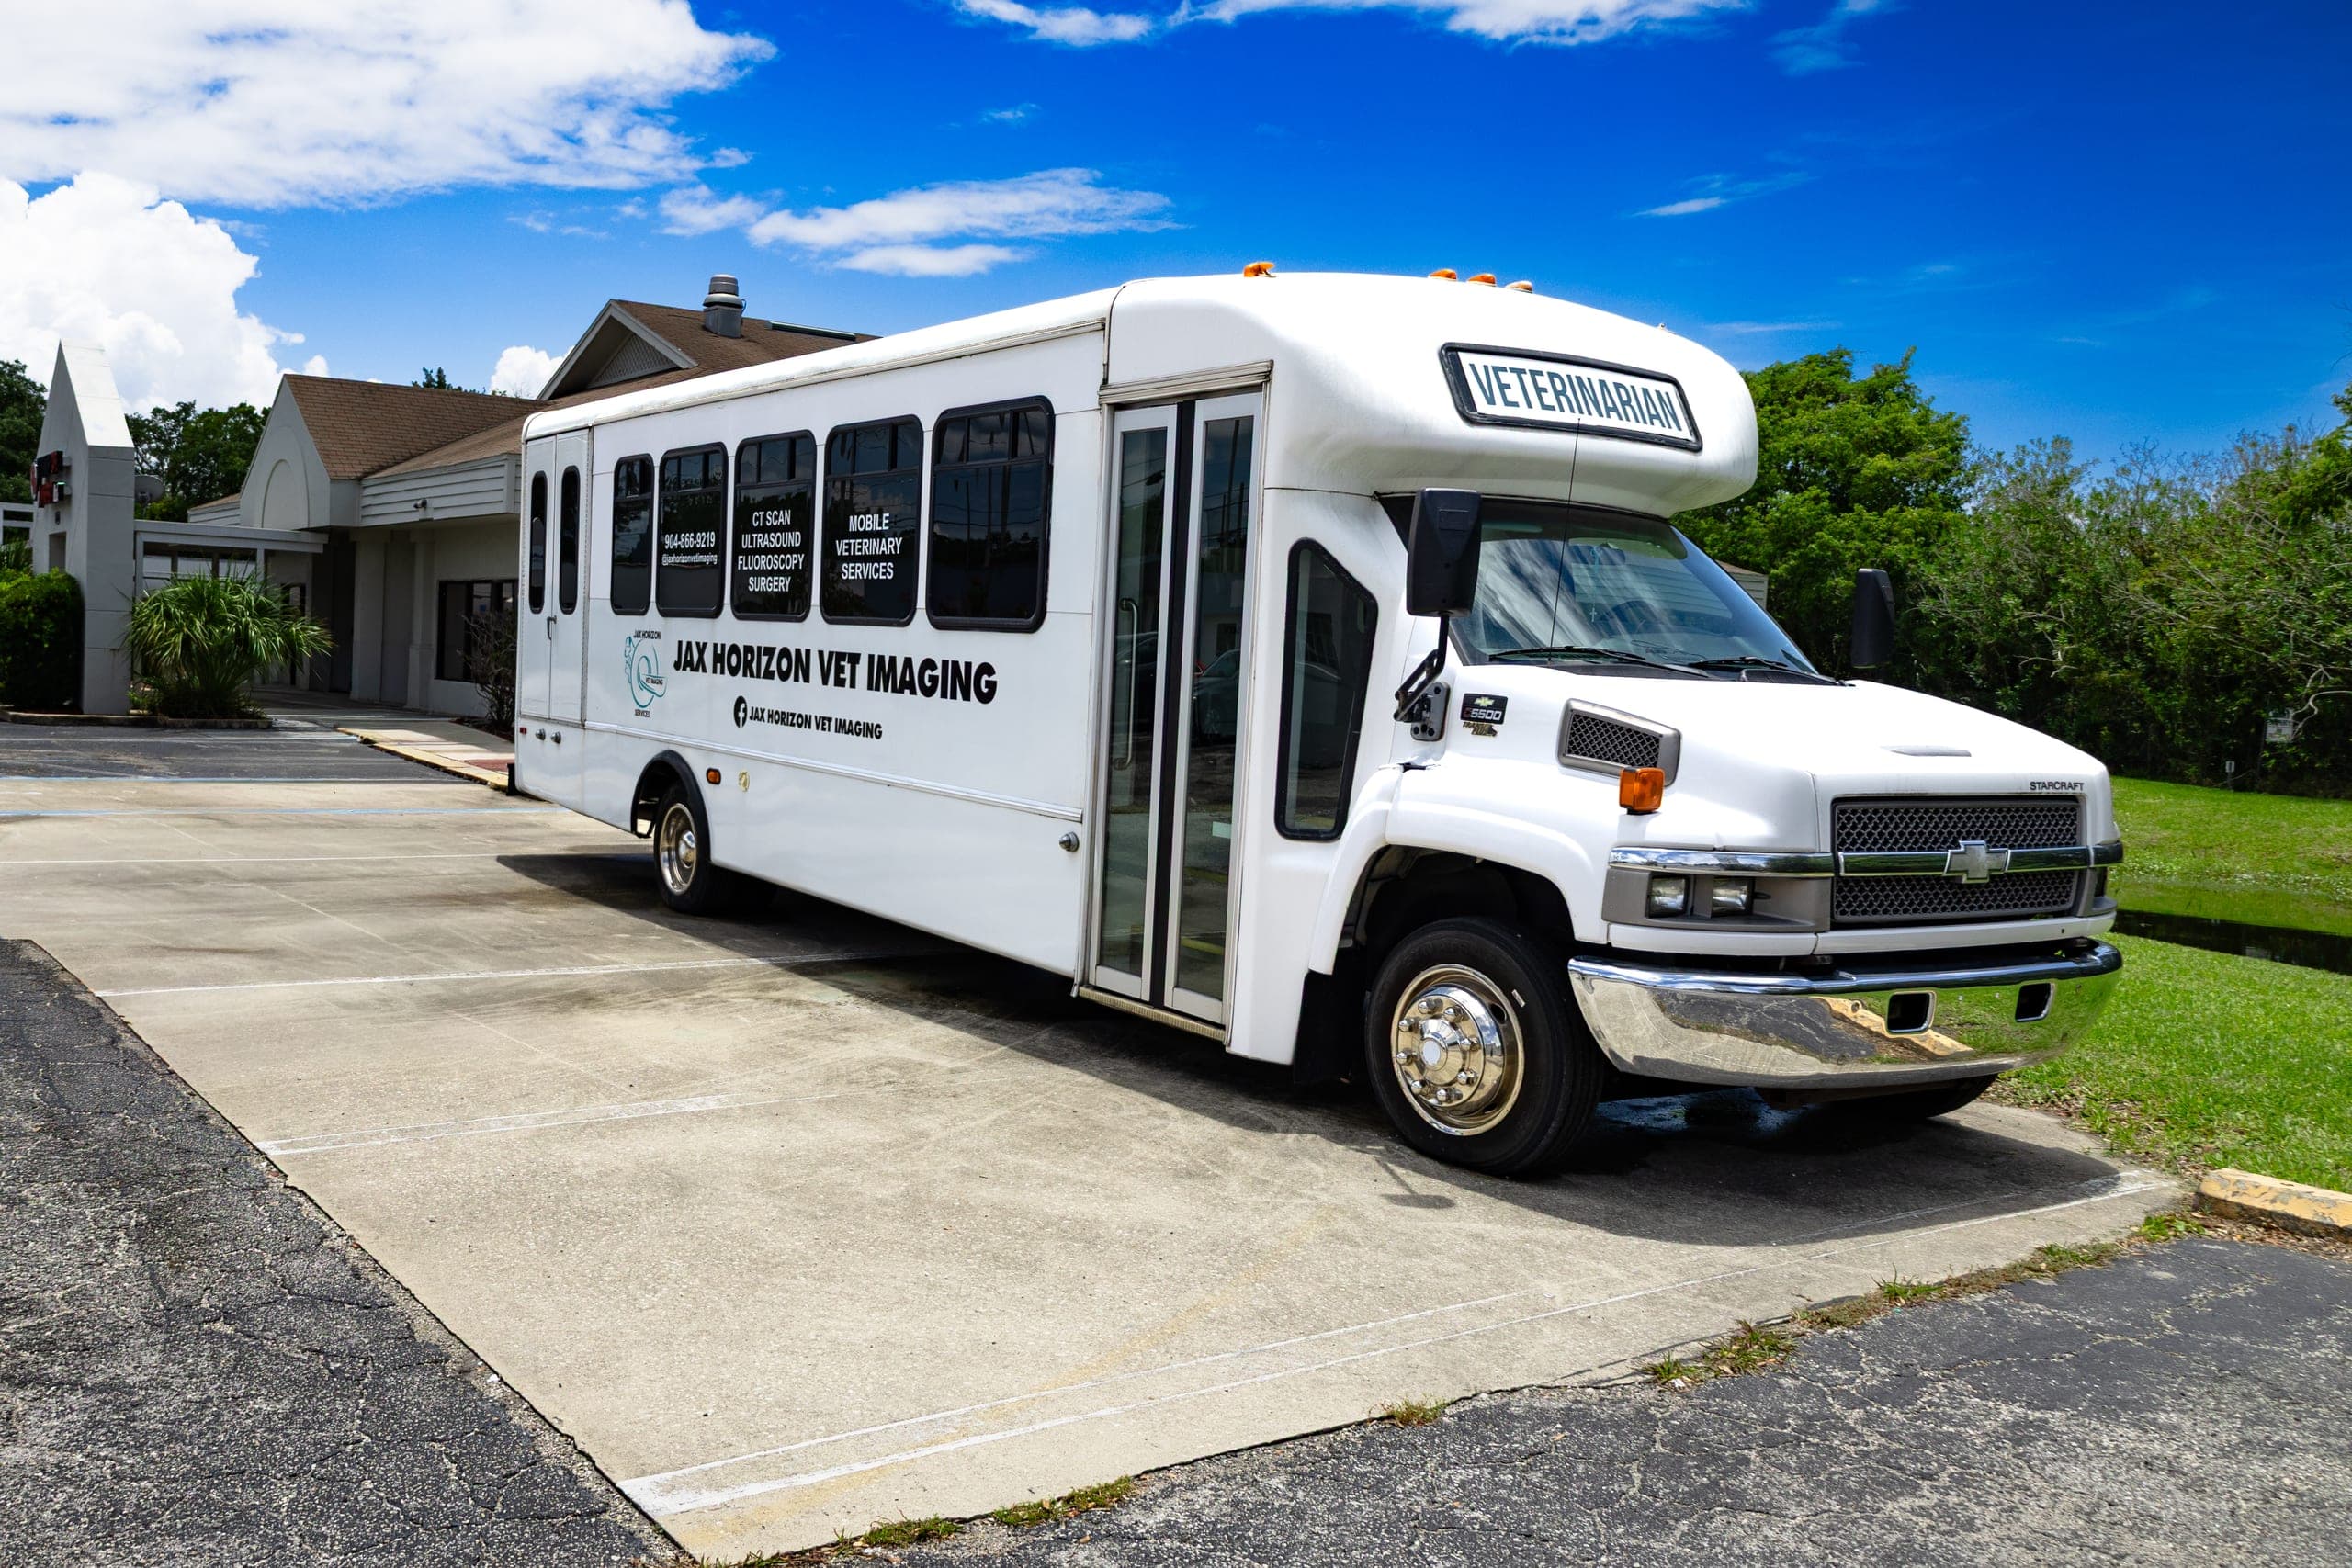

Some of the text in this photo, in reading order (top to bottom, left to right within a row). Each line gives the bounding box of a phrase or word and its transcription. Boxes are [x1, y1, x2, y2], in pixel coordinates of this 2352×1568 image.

[1469, 363, 1682, 432] VETERINARIAN
[752, 509, 791, 527] CT SCAN
[849, 513, 890, 533] MOBILE
[664, 531, 716, 549] 904-866-9219
[741, 531, 801, 549] ULTRASOUND
[835, 536, 902, 557] VETERINARY
[738, 553, 805, 570] FLUOROSCOPY
[842, 562, 894, 581] SERVICES
[748, 576, 791, 592] SURGERY
[673, 640, 998, 705] JAX HORIZON VET IMAGING
[749, 706, 883, 740] JAX HORIZON VET IMAGING
[2030, 781, 2085, 791] STARCRAFT
